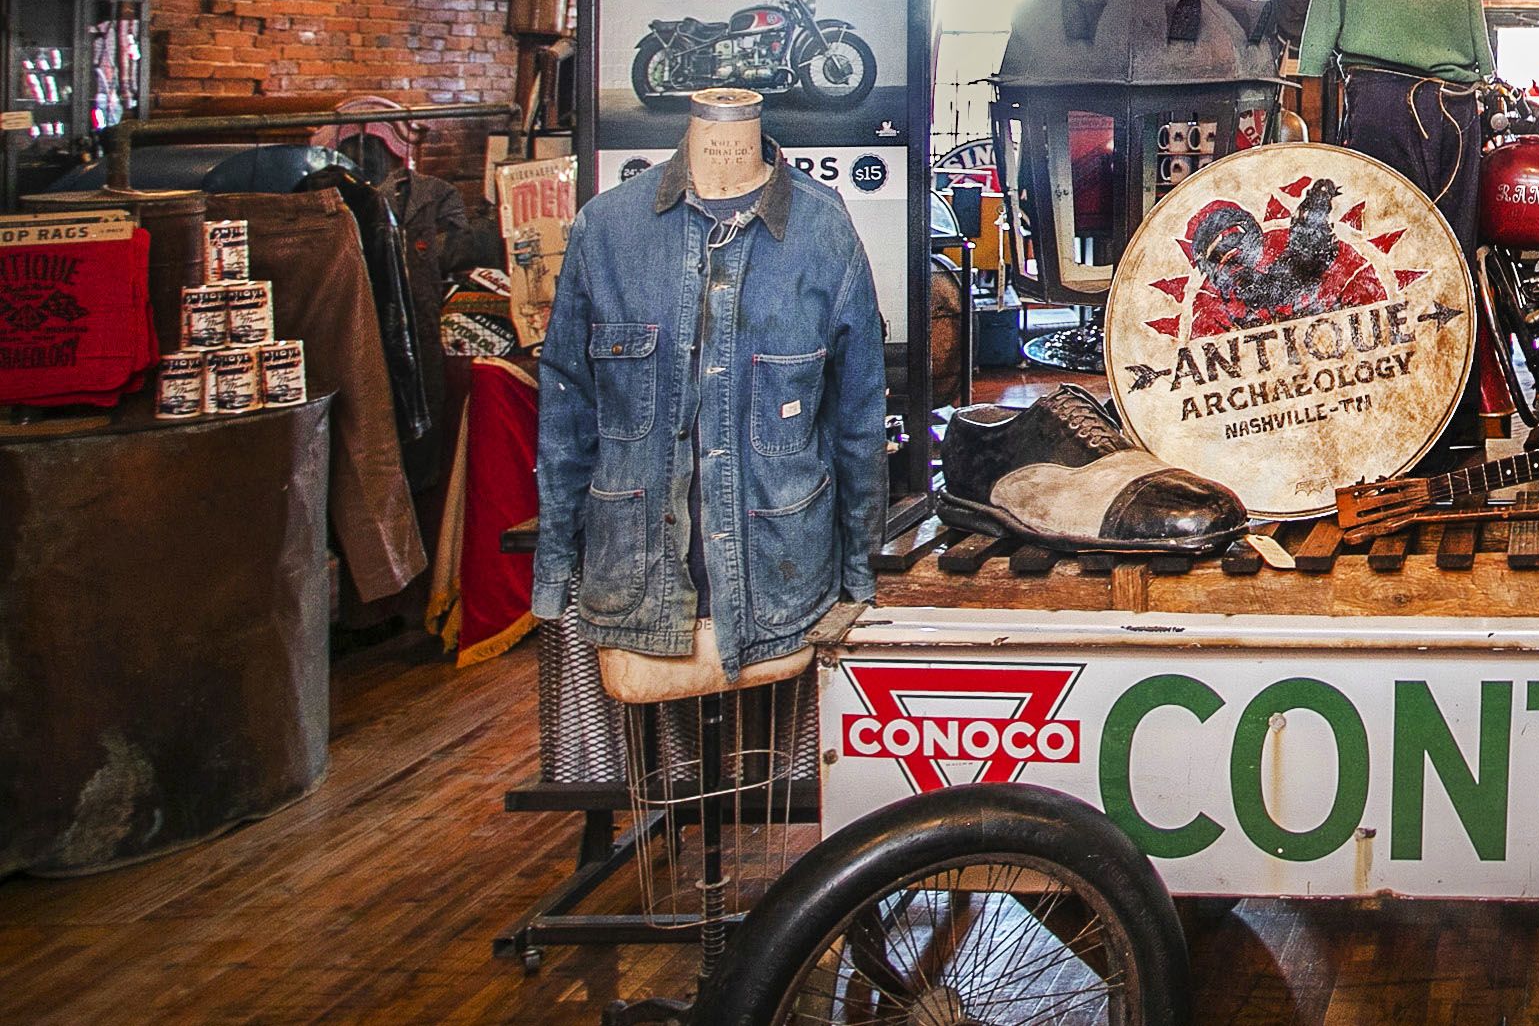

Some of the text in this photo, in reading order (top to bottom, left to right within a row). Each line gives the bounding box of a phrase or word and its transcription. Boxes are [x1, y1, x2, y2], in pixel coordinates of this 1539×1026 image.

[855, 165, 882, 182] $15
[38, 226, 90, 241] RAGS
[1170, 300, 1418, 392] ANTIQUE
[1181, 350, 1416, 422] ARCHAEOLOGY
[847, 718, 1075, 763] CONOCO
